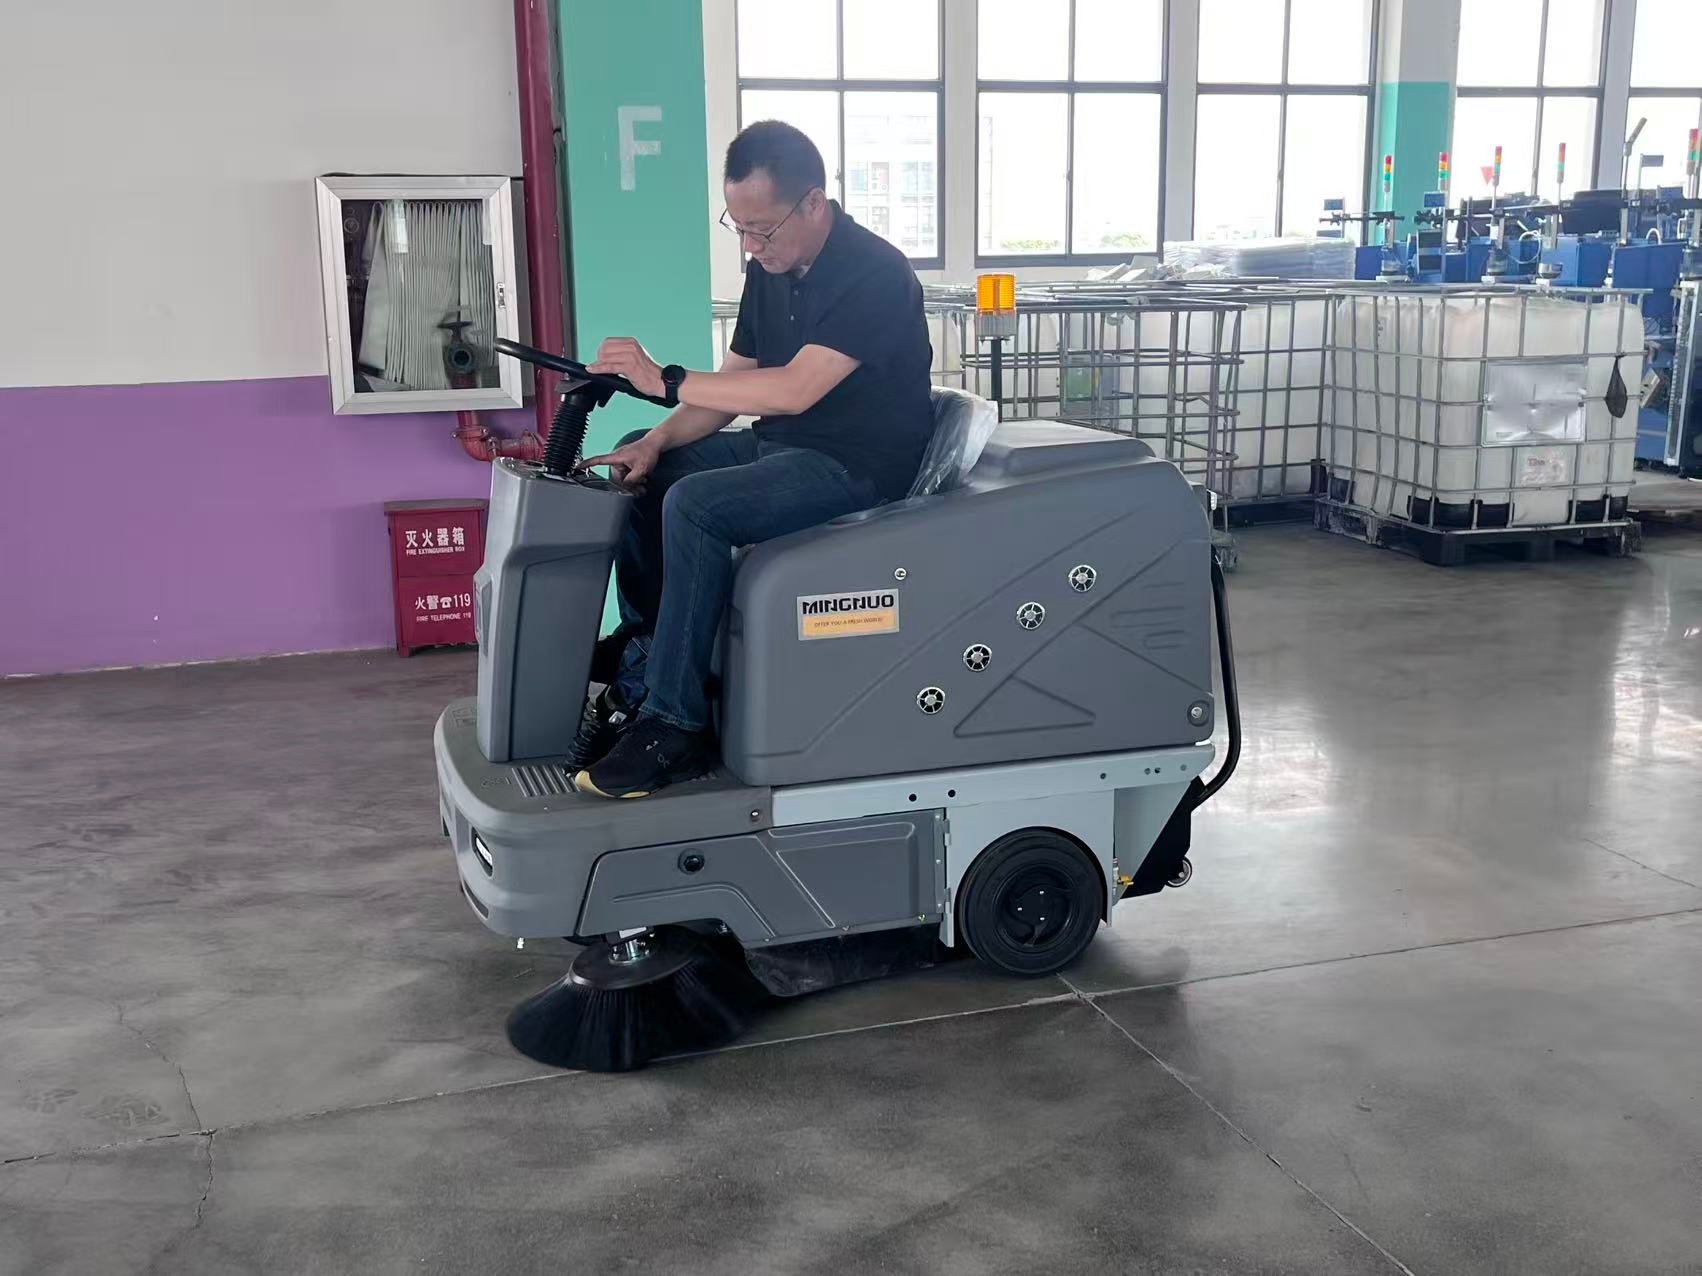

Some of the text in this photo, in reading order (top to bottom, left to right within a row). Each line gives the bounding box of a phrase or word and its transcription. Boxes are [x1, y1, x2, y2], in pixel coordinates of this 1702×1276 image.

[618, 106, 662, 191] F
[405, 527, 464, 548] 灭火器箱
[453, 593, 471, 607] 119
[802, 595, 894, 614] MINGNUO
